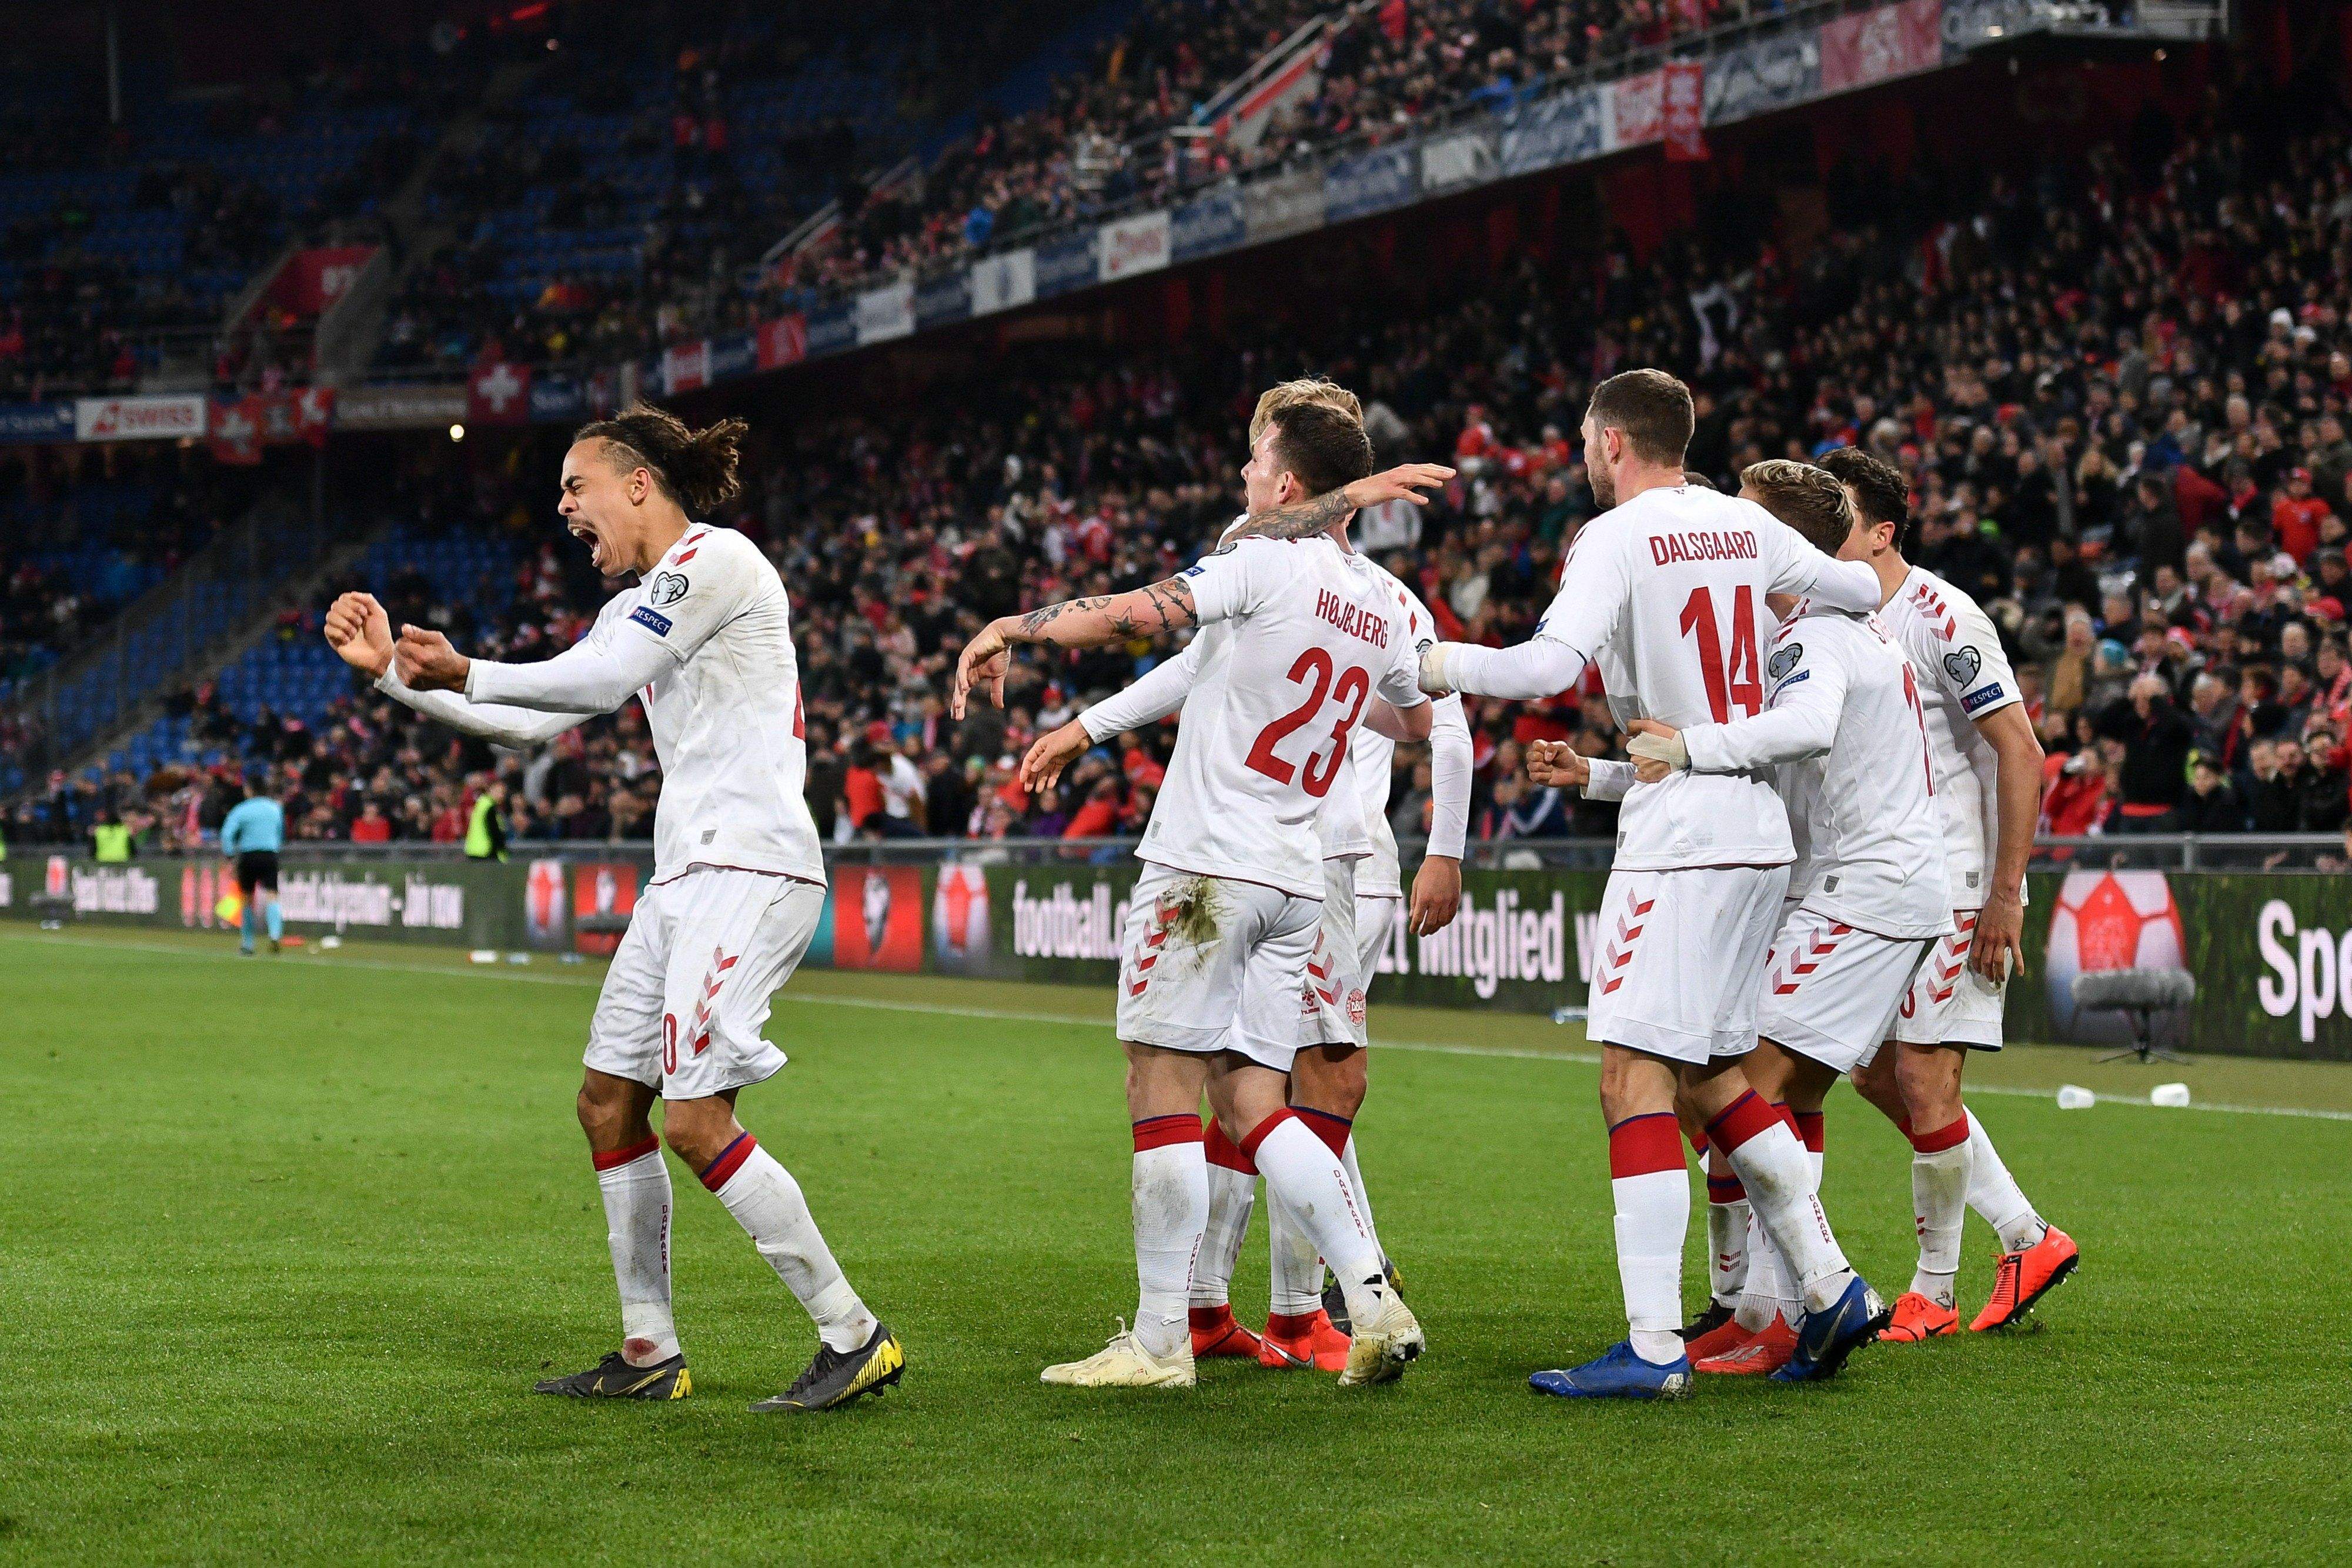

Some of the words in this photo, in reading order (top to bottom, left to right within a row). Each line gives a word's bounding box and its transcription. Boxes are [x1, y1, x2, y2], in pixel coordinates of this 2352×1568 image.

[1649, 530, 1758, 567] DALSGAARD
[634, 609, 670, 632] RESPECT
[1315, 587, 1388, 650] HØJBJERG
[1679, 584, 1763, 725] 14
[1244, 647, 1370, 798] 23
[1969, 686, 2002, 706] RESPECT
[1333, 1169, 1368, 1239] DANMARK
[1809, 1193, 1832, 1244] DANMARK
[660, 1204, 669, 1275] DANMARK
